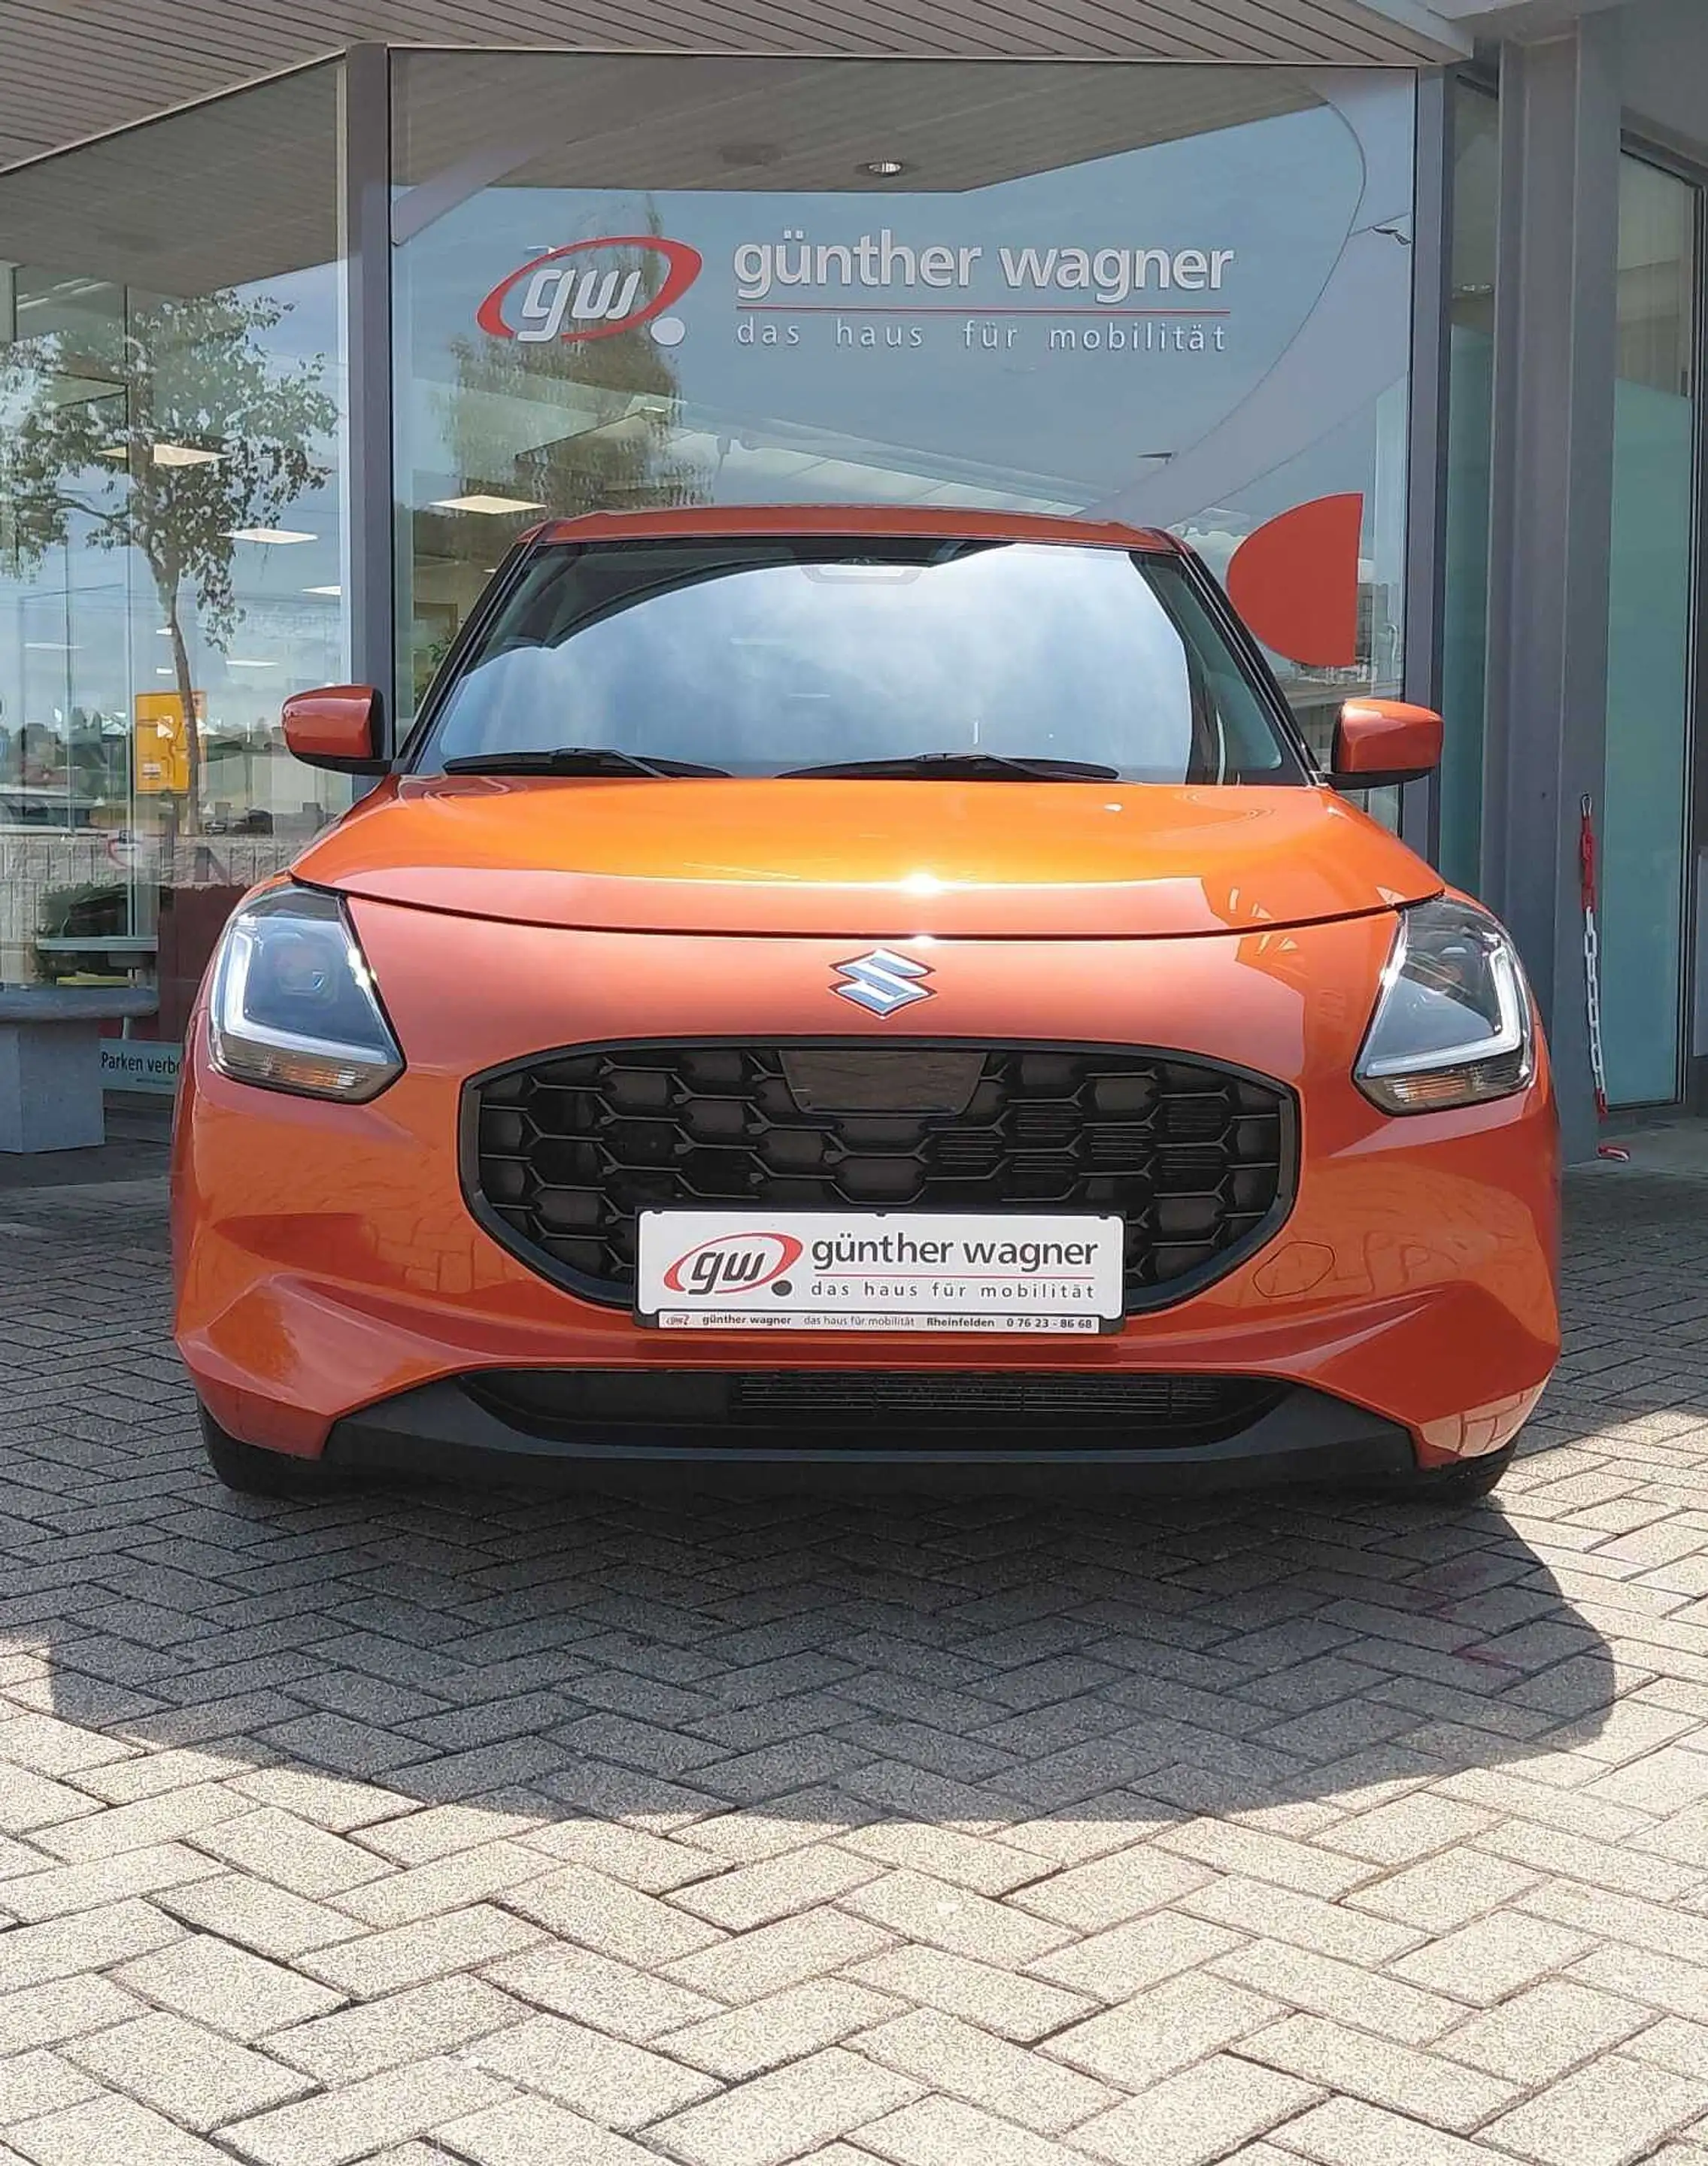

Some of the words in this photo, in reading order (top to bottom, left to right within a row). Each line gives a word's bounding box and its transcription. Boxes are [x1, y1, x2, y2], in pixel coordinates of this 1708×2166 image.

[734, 229, 982, 299] günther
[1000, 247, 1235, 303] wagner
[736, 317, 801, 344] das
[836, 318, 923, 347] haus
[963, 320, 1018, 348] für
[1049, 322, 1226, 351] mobilität
[102, 1051, 143, 1071] Parken
[812, 1232, 954, 1270] günther
[963, 1242, 1099, 1273] wagner
[811, 1281, 849, 1296] das
[865, 1281, 918, 1297] haus
[932, 1282, 966, 1297] für
[981, 1282, 1094, 1299] mobilität
[702, 1314, 746, 1326] günther
[751, 1316, 791, 1326] wagner
[804, 1315, 821, 1325] das
[824, 1315, 848, 1326] haus
[851, 1316, 866, 1326] für
[868, 1316, 915, 1327] mobilität
[927, 1317, 995, 1327] Rheinfelden
